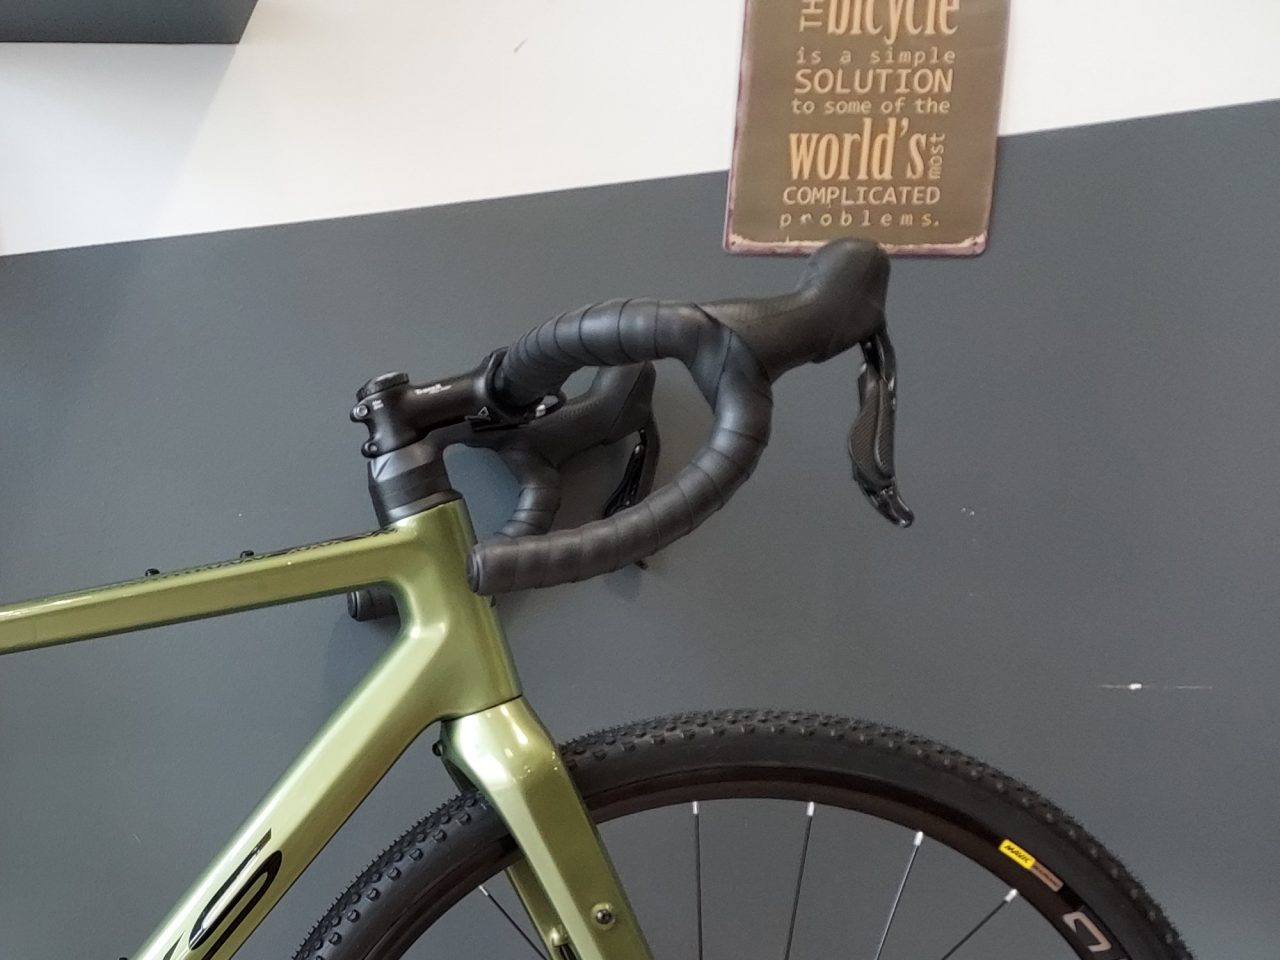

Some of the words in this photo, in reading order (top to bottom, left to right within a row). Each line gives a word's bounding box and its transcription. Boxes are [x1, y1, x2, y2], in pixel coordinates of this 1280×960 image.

[796, 46, 821, 64] is
[840, 50, 851, 64] a
[870, 46, 956, 66] simple
[794, 68, 954, 94] SOLUTION
[791, 98, 815, 114] to
[824, 99, 872, 114] some
[880, 97, 905, 114] of
[915, 97, 951, 114] the
[789, 117, 928, 180] world's
[928, 132, 946, 179] most
[782, 186, 941, 206] COMPLICATED
[779, 208, 941, 229] problems.
